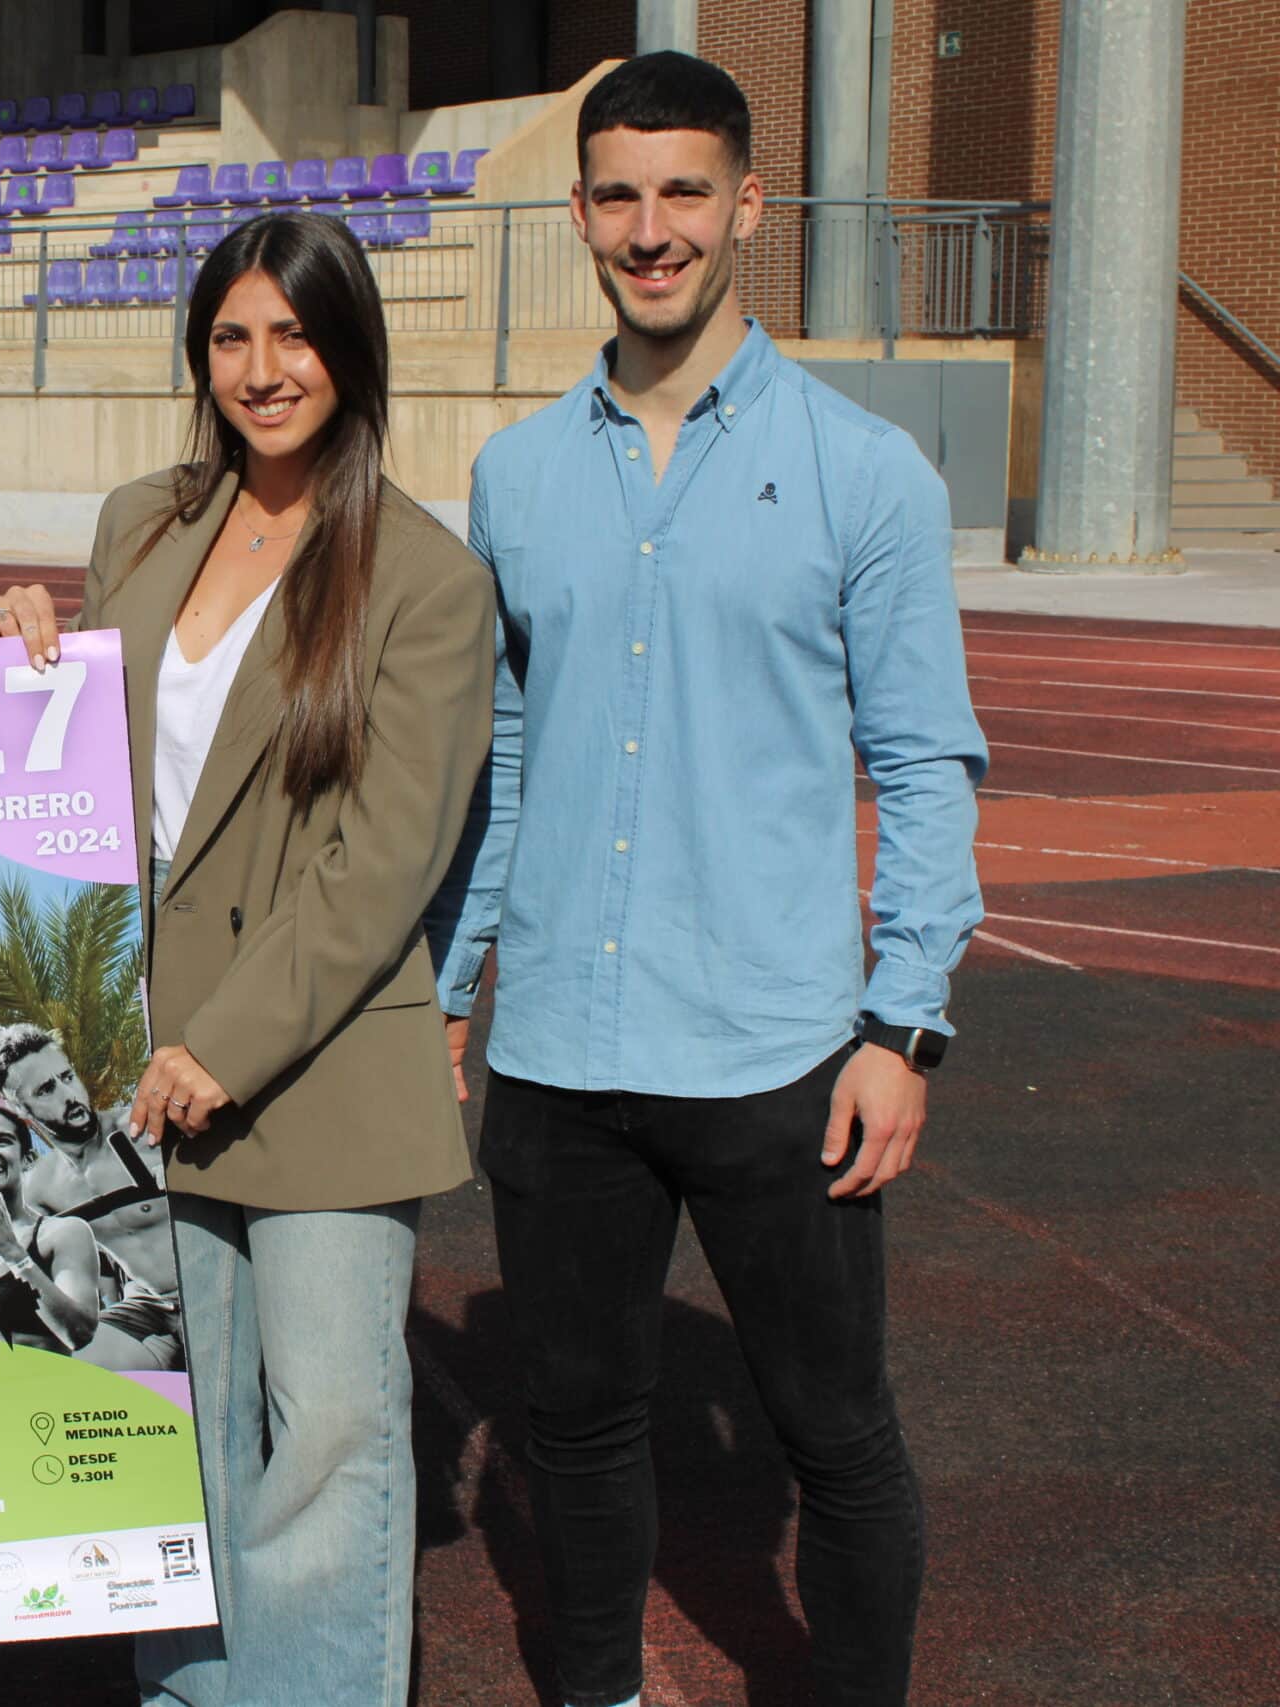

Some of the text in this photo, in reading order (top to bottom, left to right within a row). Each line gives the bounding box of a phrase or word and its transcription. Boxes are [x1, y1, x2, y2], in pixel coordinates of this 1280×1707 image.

[35, 826, 121, 856] 2024
[63, 1410, 128, 1423] ESTADIO
[65, 1425, 177, 1440] MEDINA LAUXA
[68, 1453, 118, 1465] DESDE
[70, 1471, 114, 1483] 9.30H
